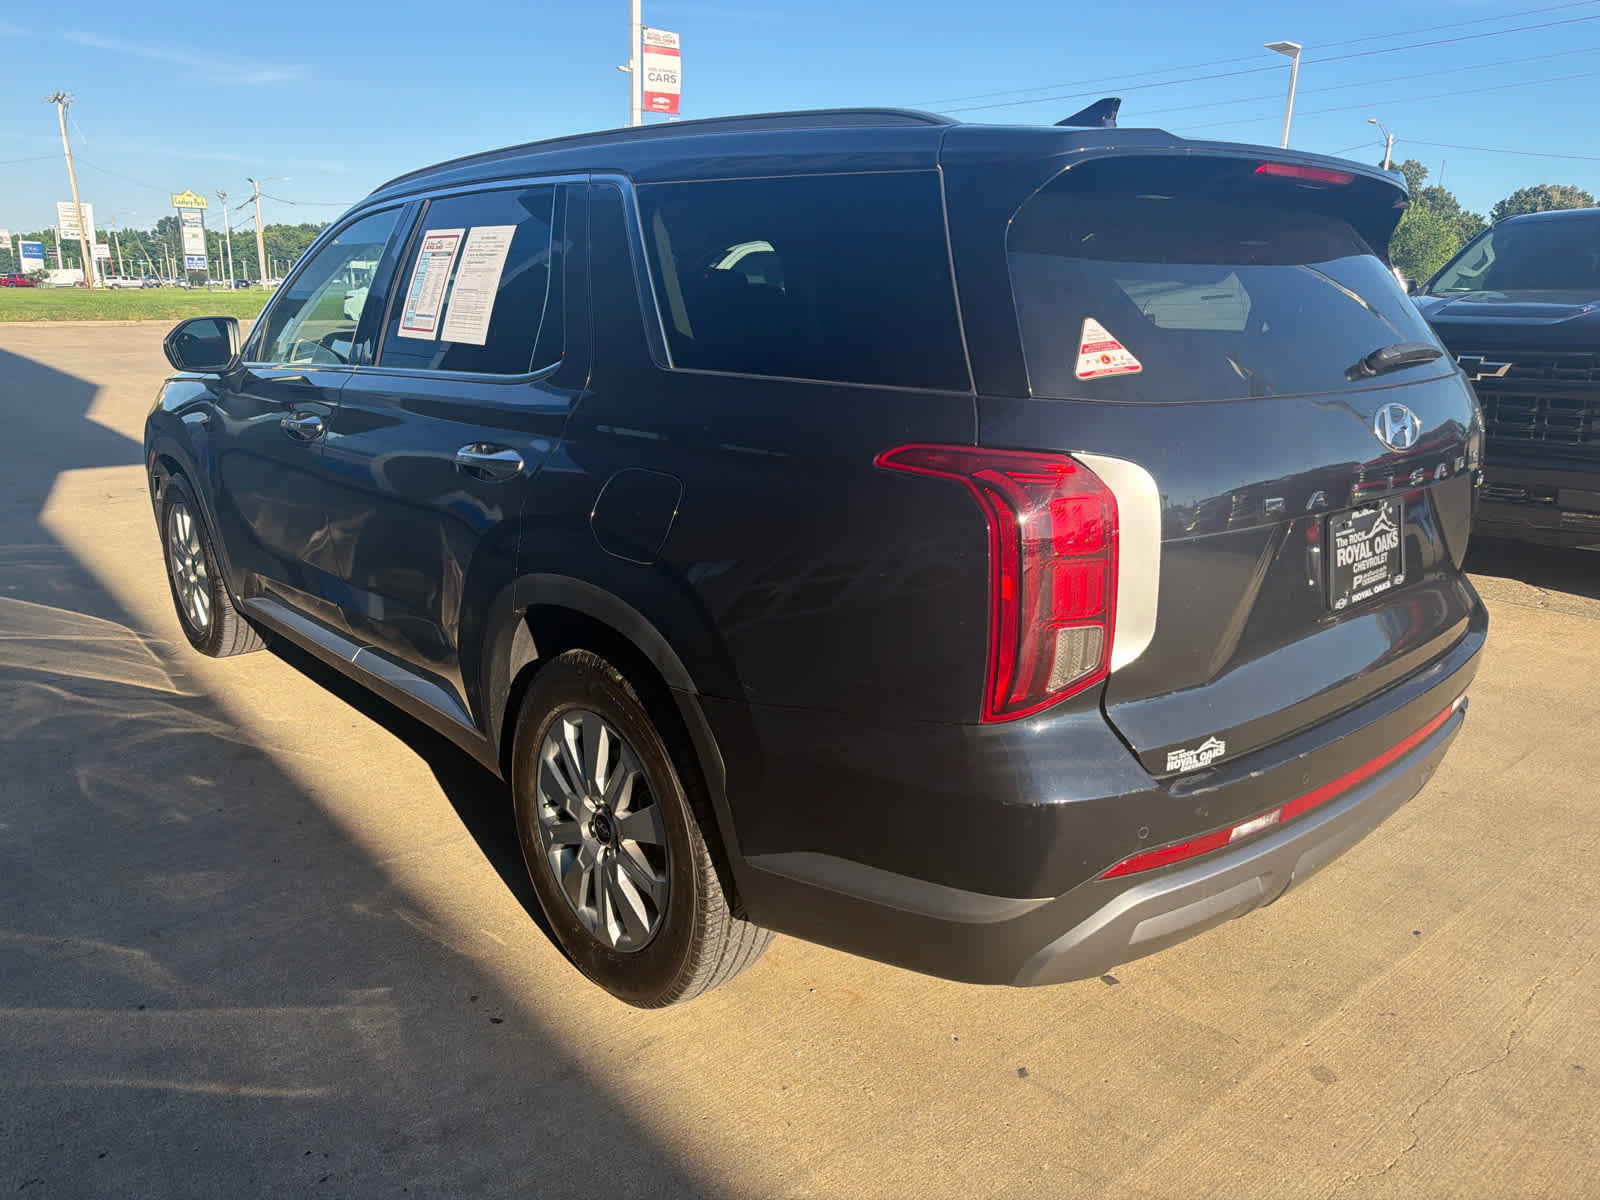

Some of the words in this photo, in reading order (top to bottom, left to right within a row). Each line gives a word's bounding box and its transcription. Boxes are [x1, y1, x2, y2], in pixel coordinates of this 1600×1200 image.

[648, 73, 677, 84] CARS
[1336, 536, 1349, 549] The
[1349, 531, 1367, 545] ROCK
[1336, 540, 1373, 568] ROYAL
[1374, 530, 1399, 554] OAKS
[1353, 551, 1388, 573] CHEVROLET
[1352, 588, 1374, 603] ROYAL
[1166, 754, 1199, 771] ROYAL
[1199, 746, 1225, 761] OAKS
